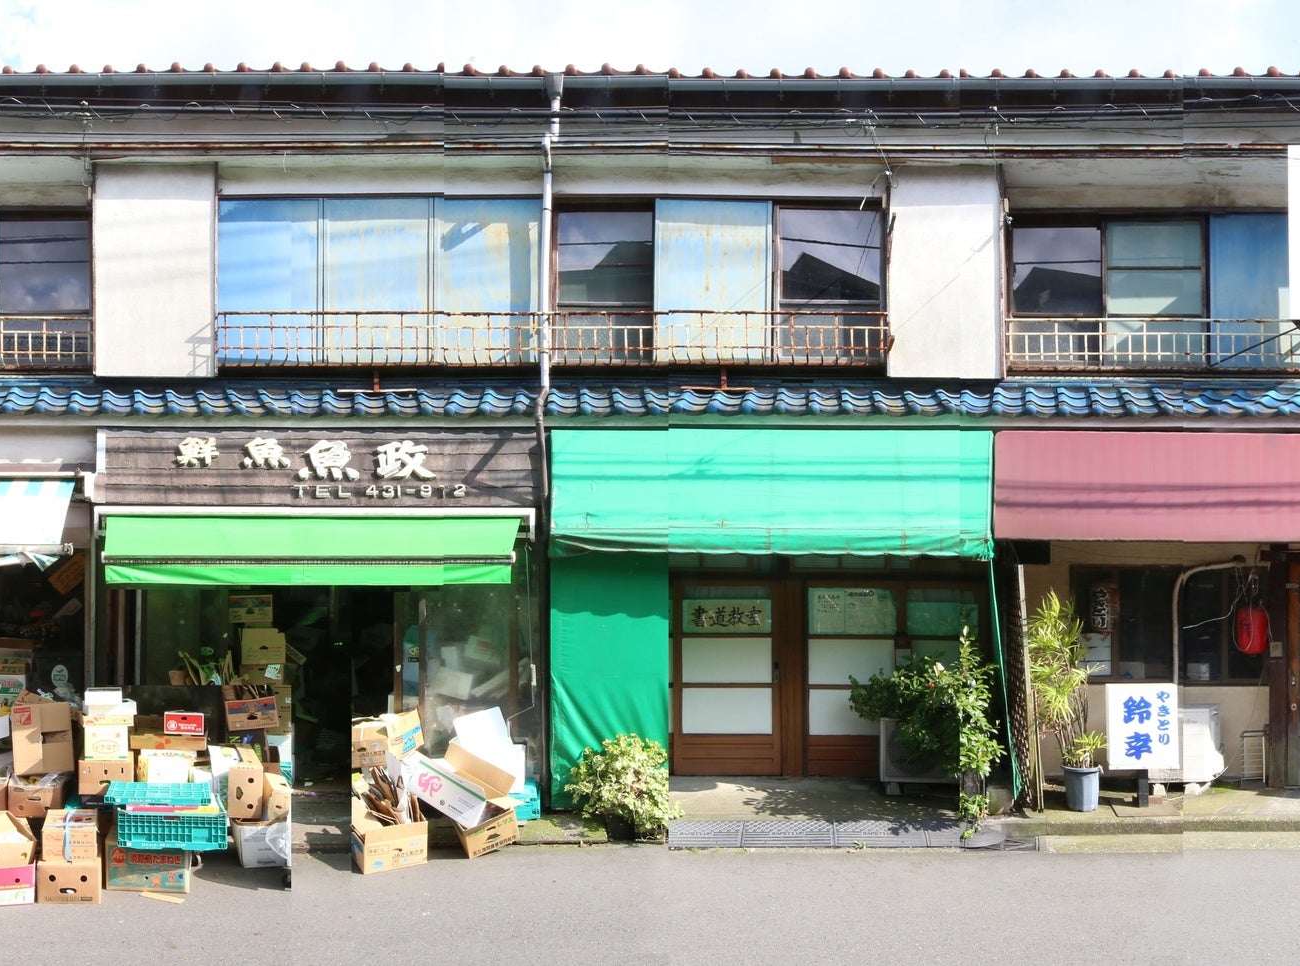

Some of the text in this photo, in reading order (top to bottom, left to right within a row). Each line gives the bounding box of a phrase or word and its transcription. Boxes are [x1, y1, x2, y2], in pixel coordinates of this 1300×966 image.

[298, 439, 437, 481] 魚政
[294, 484, 352, 499] TEL
[691, 605, 763, 627] 書道教室
[1123, 696, 1153, 760] 鈴幸
[1156, 690, 1170, 745] やきとり
